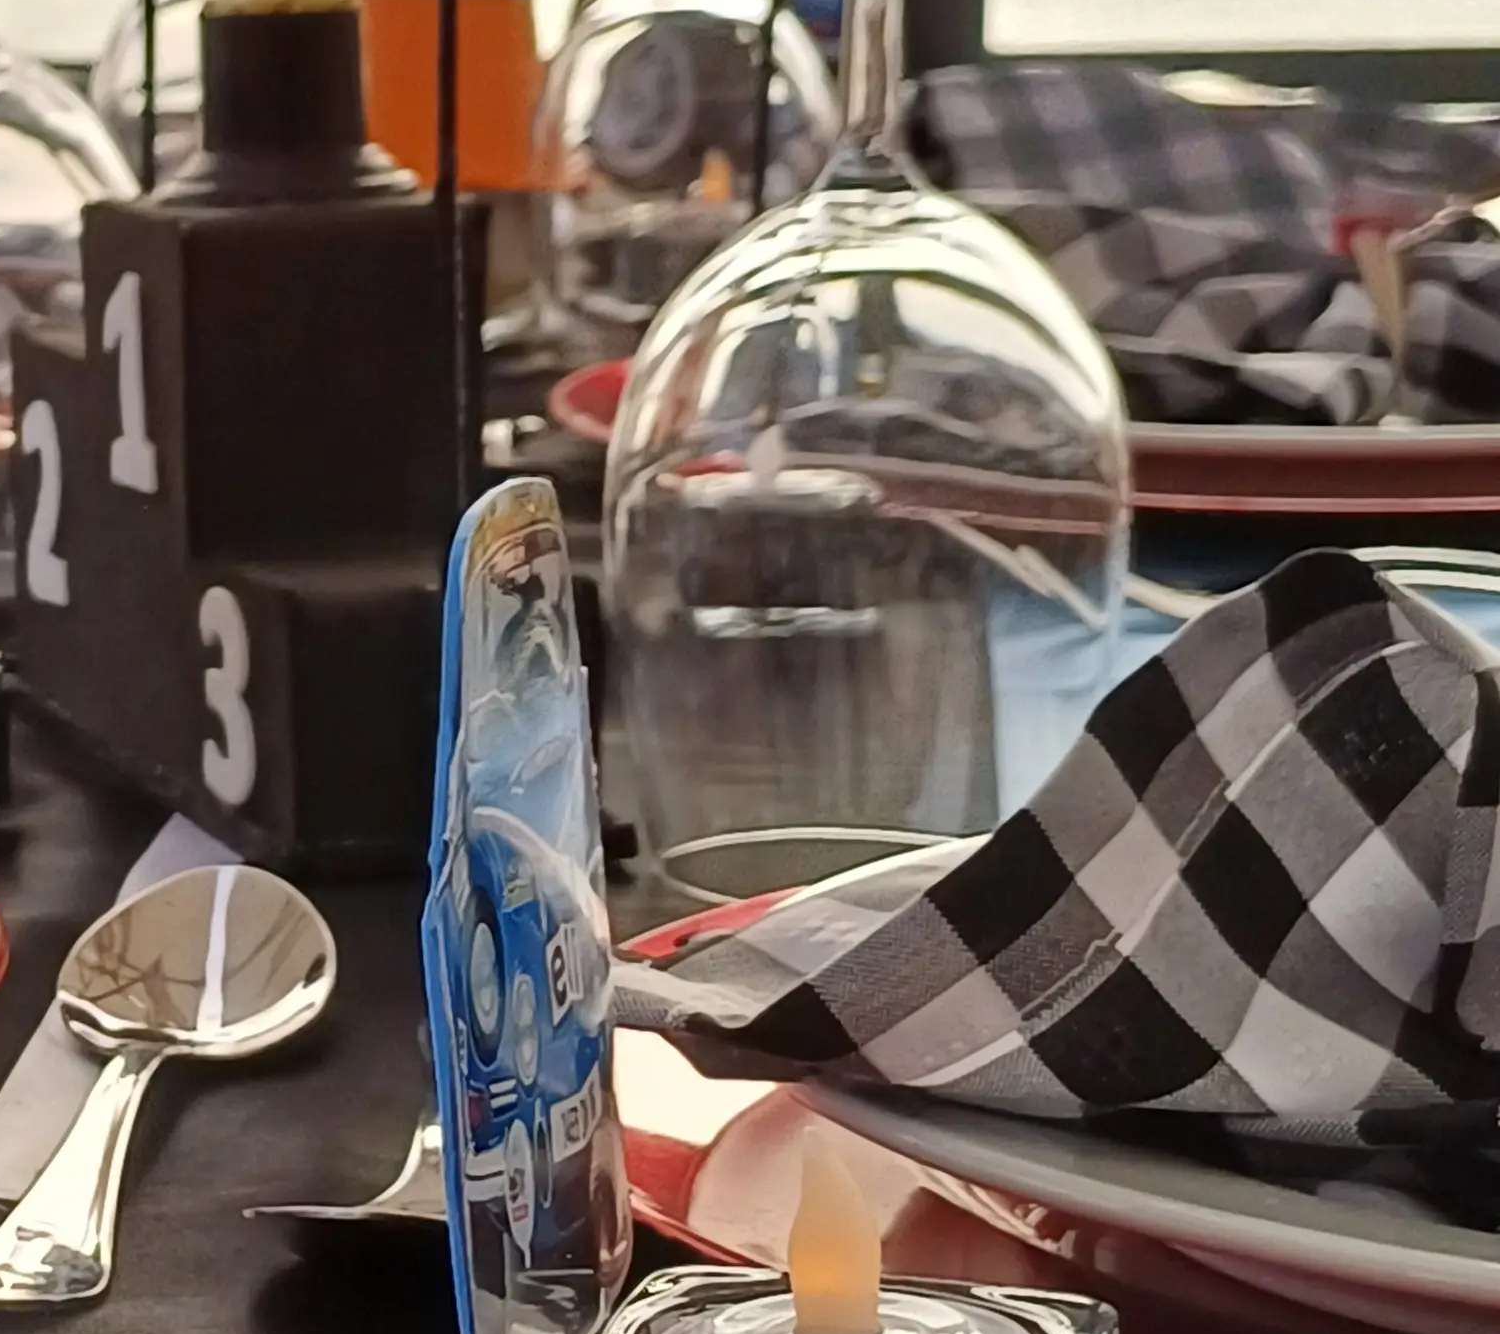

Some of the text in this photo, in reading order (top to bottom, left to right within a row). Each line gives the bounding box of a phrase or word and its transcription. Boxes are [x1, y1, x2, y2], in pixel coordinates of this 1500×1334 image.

[102, 271, 158, 494] 1
[21, 399, 69, 606] 2
[200, 586, 256, 806] 3
